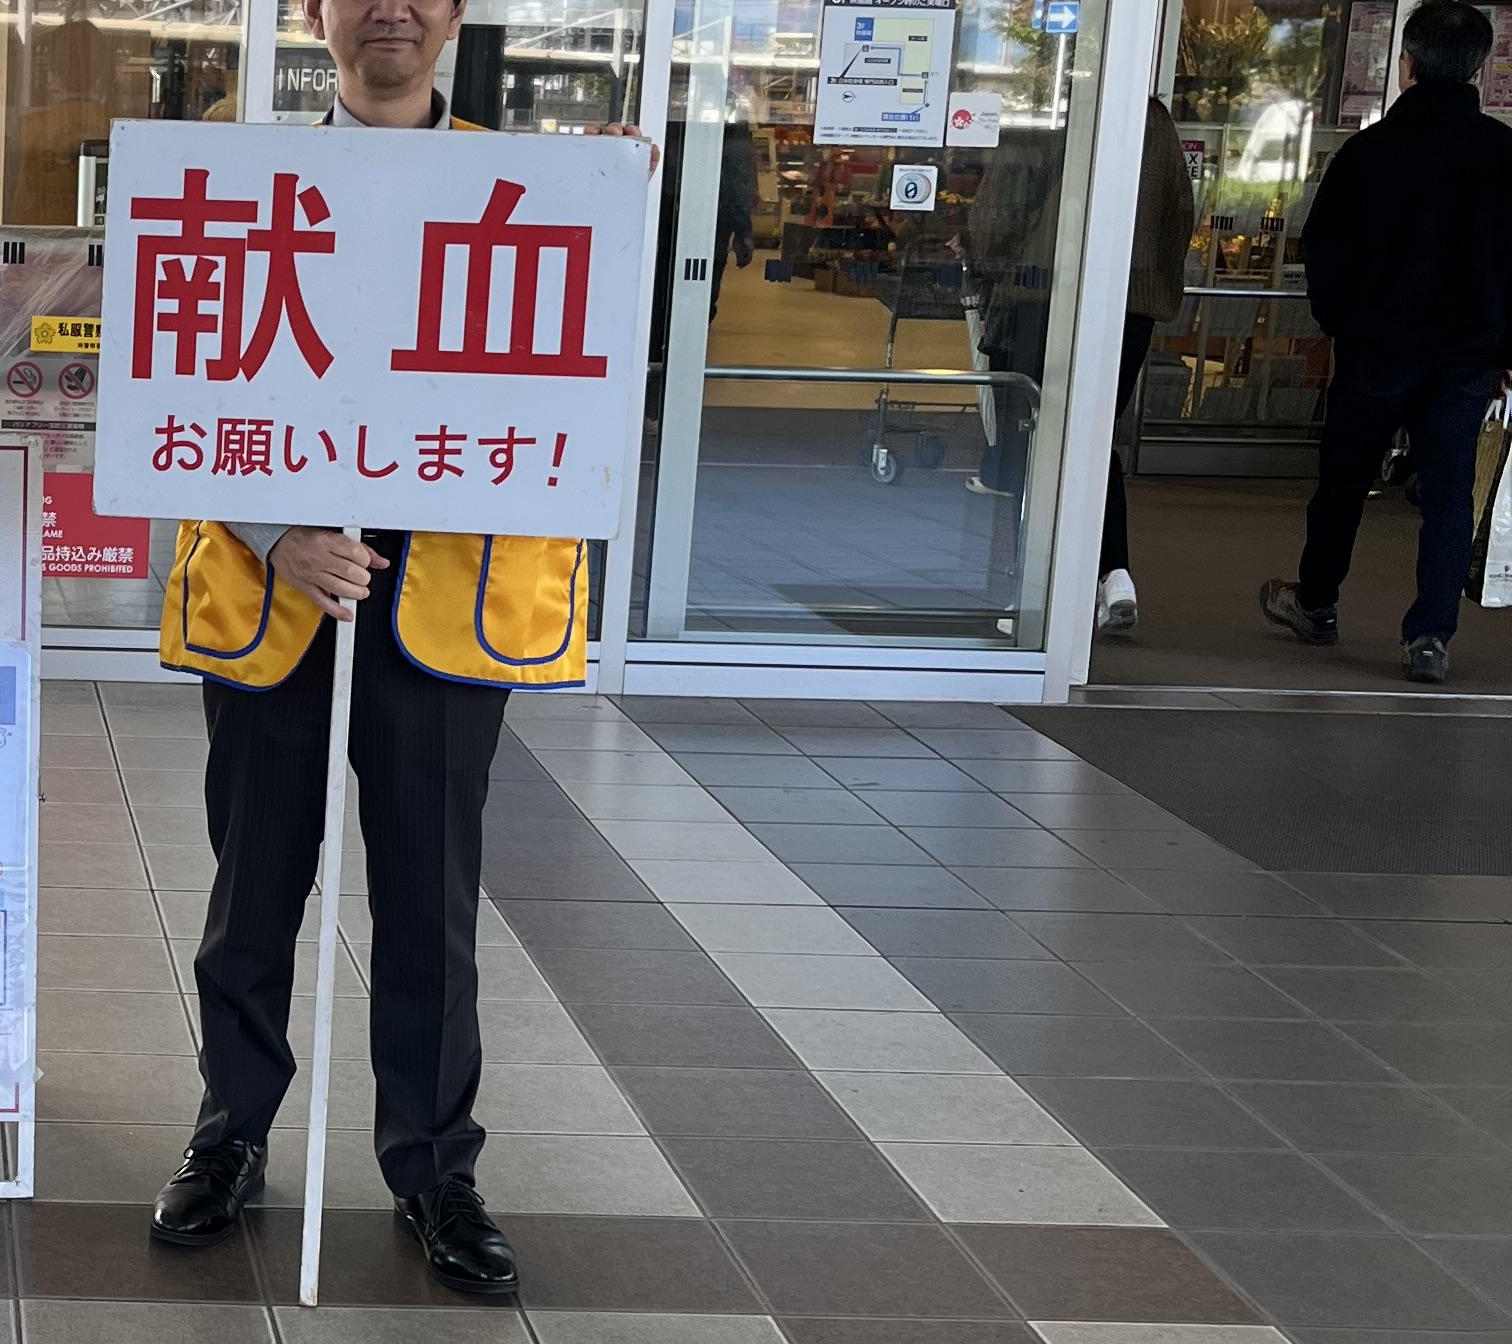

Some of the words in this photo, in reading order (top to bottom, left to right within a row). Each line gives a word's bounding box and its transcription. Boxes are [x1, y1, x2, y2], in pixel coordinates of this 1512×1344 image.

[278, 67, 338, 92] INFOR
[131, 169, 608, 382] 献血
[152, 414, 568, 488] お願いします！
[49, 564, 82, 572] GOODS
[85, 564, 134, 573] PROHIBITED
